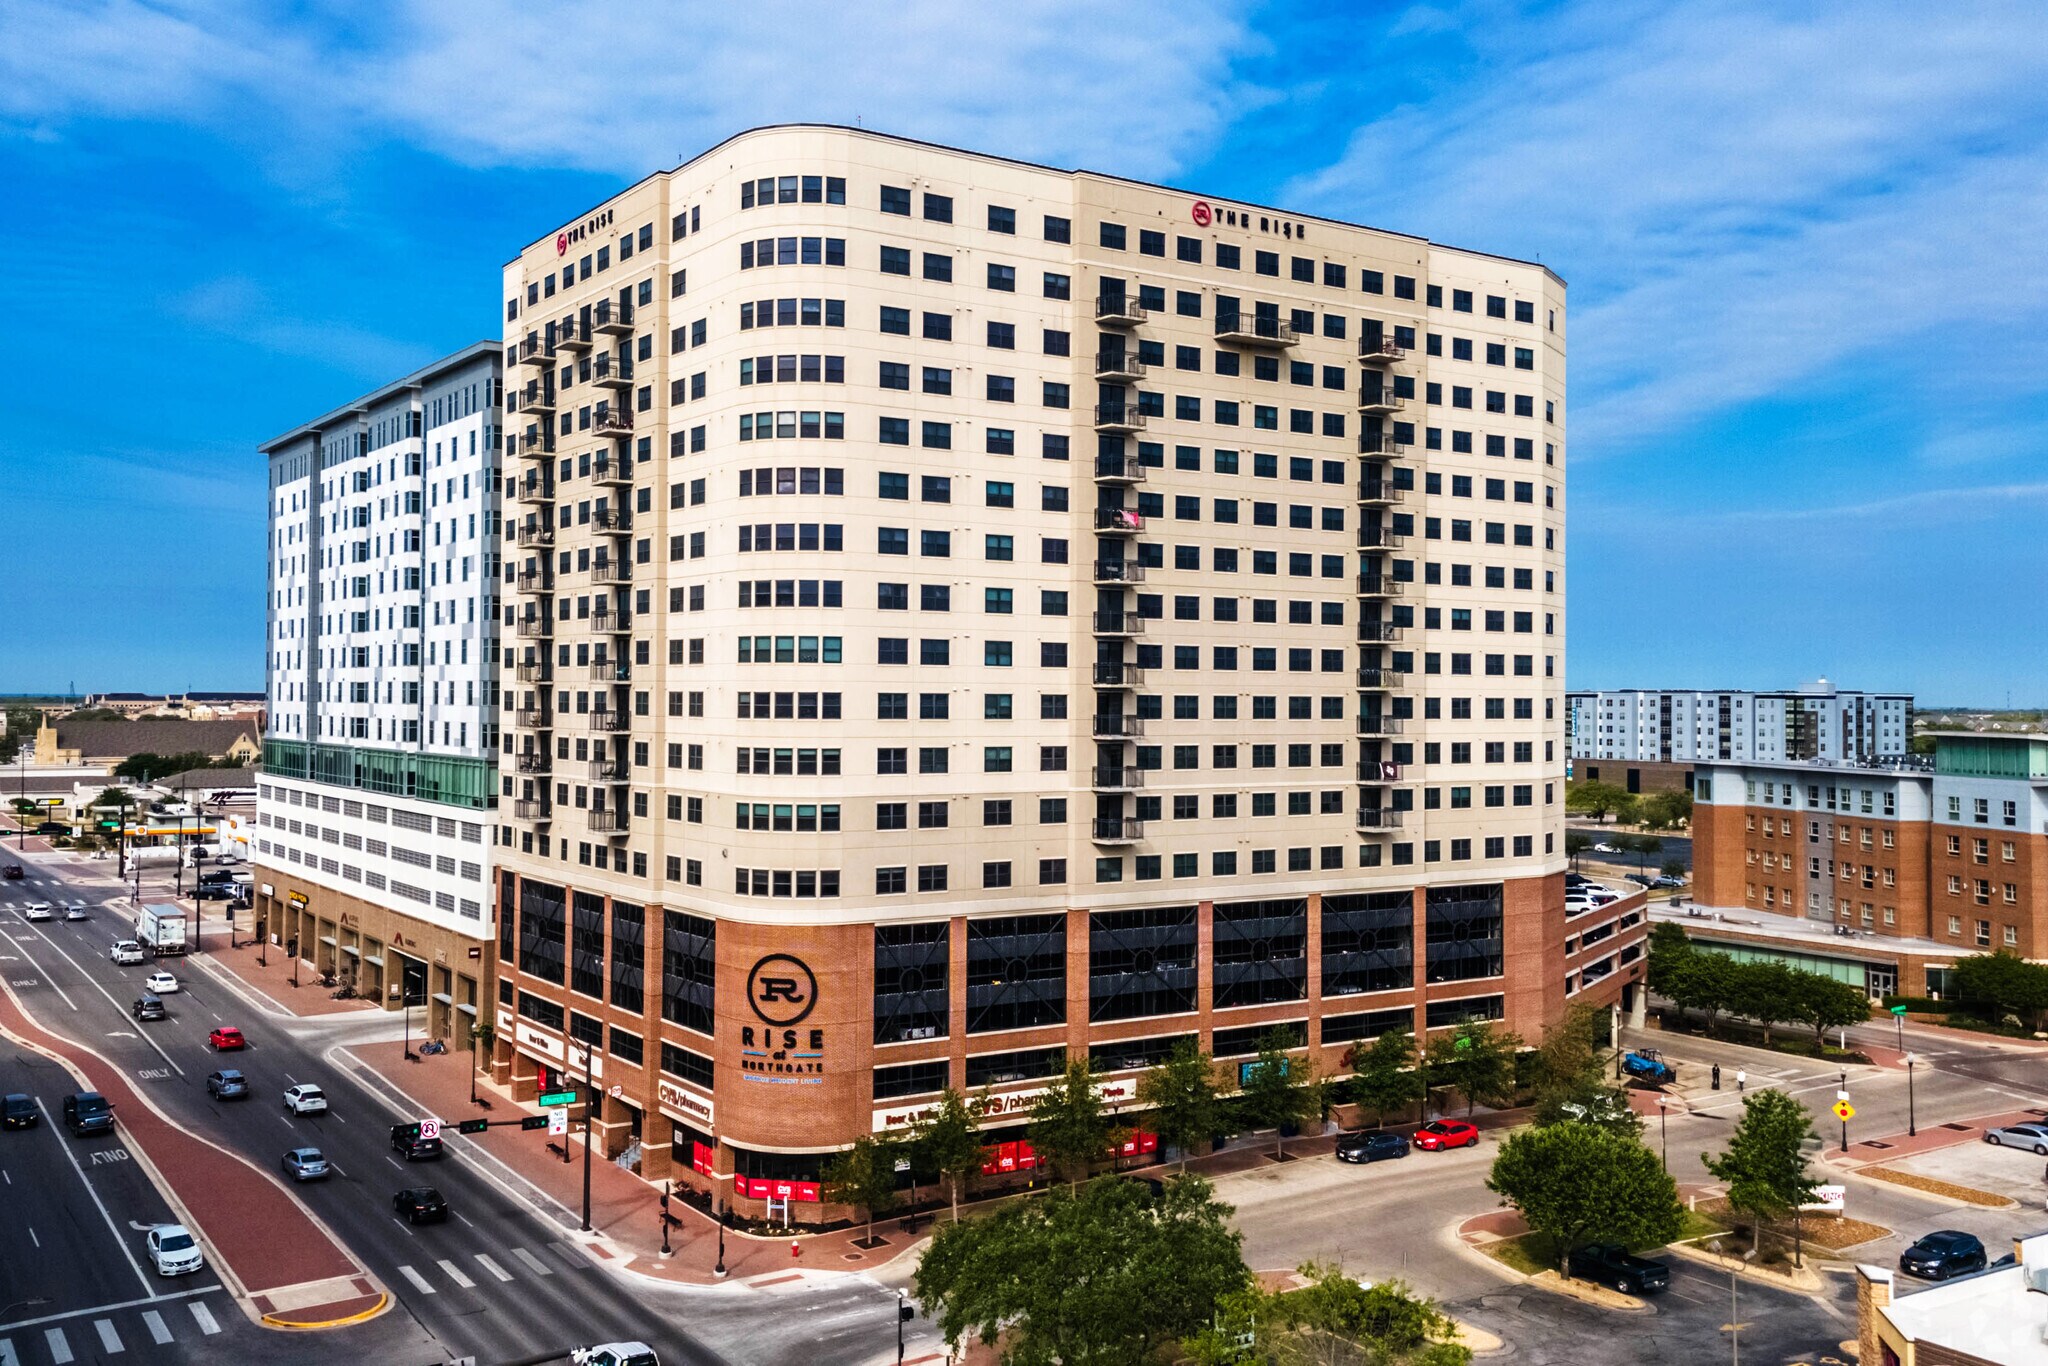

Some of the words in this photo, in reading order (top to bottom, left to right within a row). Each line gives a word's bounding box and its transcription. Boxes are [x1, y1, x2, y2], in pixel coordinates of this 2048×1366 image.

[567, 224, 585, 246] THE
[588, 208, 613, 235] RISE
[1214, 208, 1249, 229] THE
[1260, 217, 1305, 240] RISE
[11, 979, 38, 987] ONLY
[742, 1026, 823, 1049] RISE
[773, 1050, 786, 1060] at
[137, 1068, 171, 1079] ONLY
[742, 1060, 823, 1073] NORTHGATE
[659, 1084, 711, 1120] CVS/pharmacy
[968, 1093, 1045, 1117] CVS/pharm
[885, 1113, 906, 1125] Beer
[908, 1111, 917, 1123] &
[90, 1148, 129, 1165] ONLY
